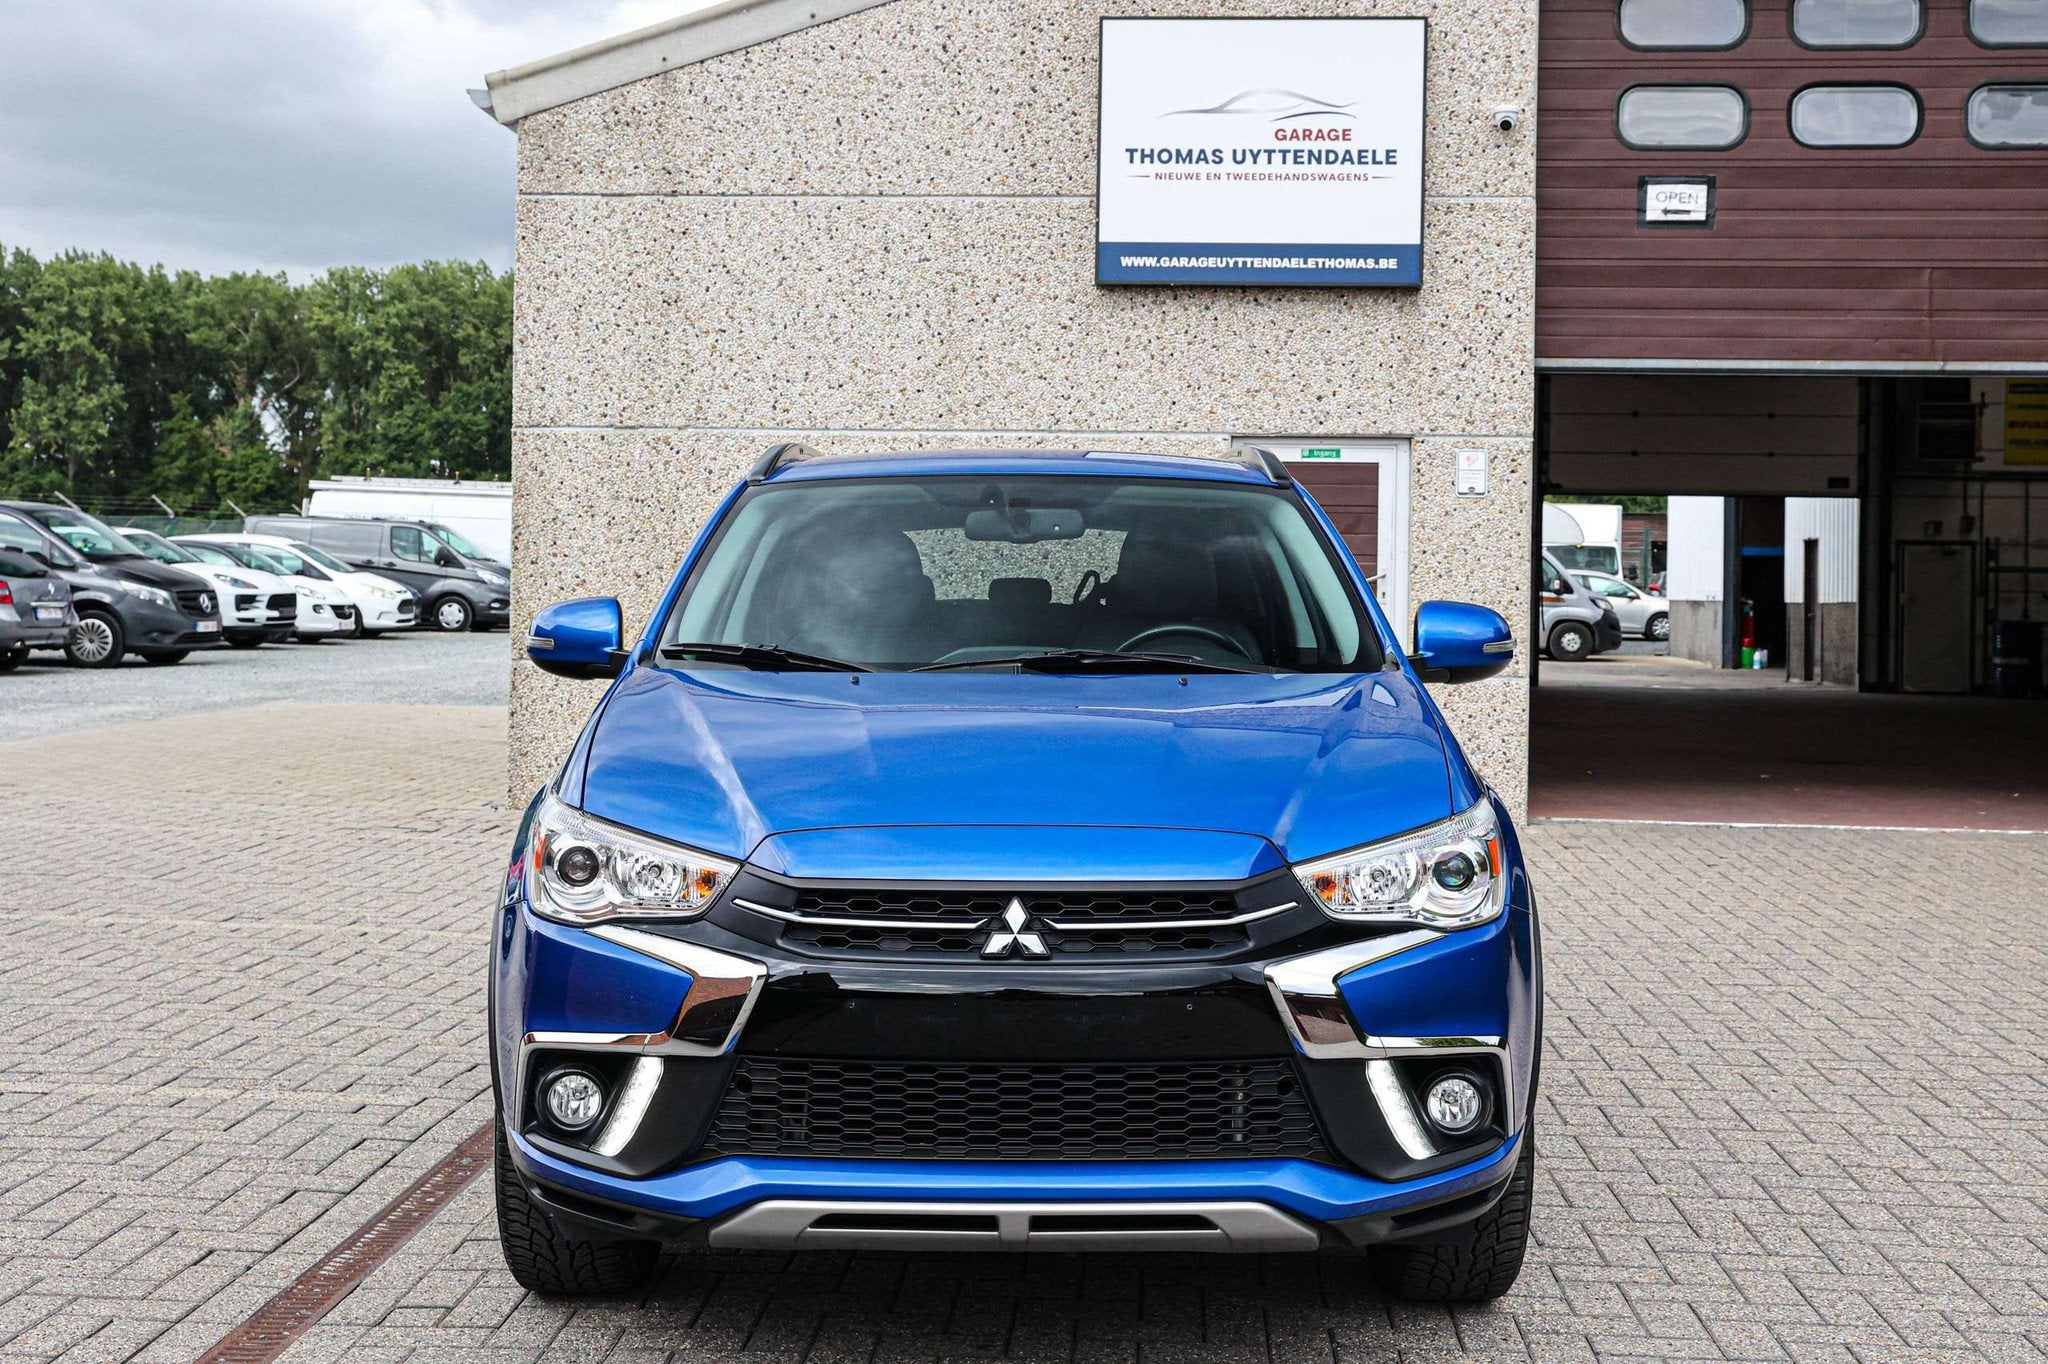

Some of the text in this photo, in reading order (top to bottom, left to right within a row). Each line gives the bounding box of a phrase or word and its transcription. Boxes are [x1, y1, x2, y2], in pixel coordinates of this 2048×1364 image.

[1274, 128, 1352, 142] GARAGE
[1125, 148, 1398, 166] THOMAS UYTTENDAELE
[1154, 172, 1369, 182] NIEUWE EN TWEEDEHANDSWAGENS
[1656, 191, 1698, 204] OPEN
[1120, 255, 1398, 270] WWW.GARAGEUYTTENDAELETHOMAS.BE
[1313, 449, 1337, 458] Ingang
